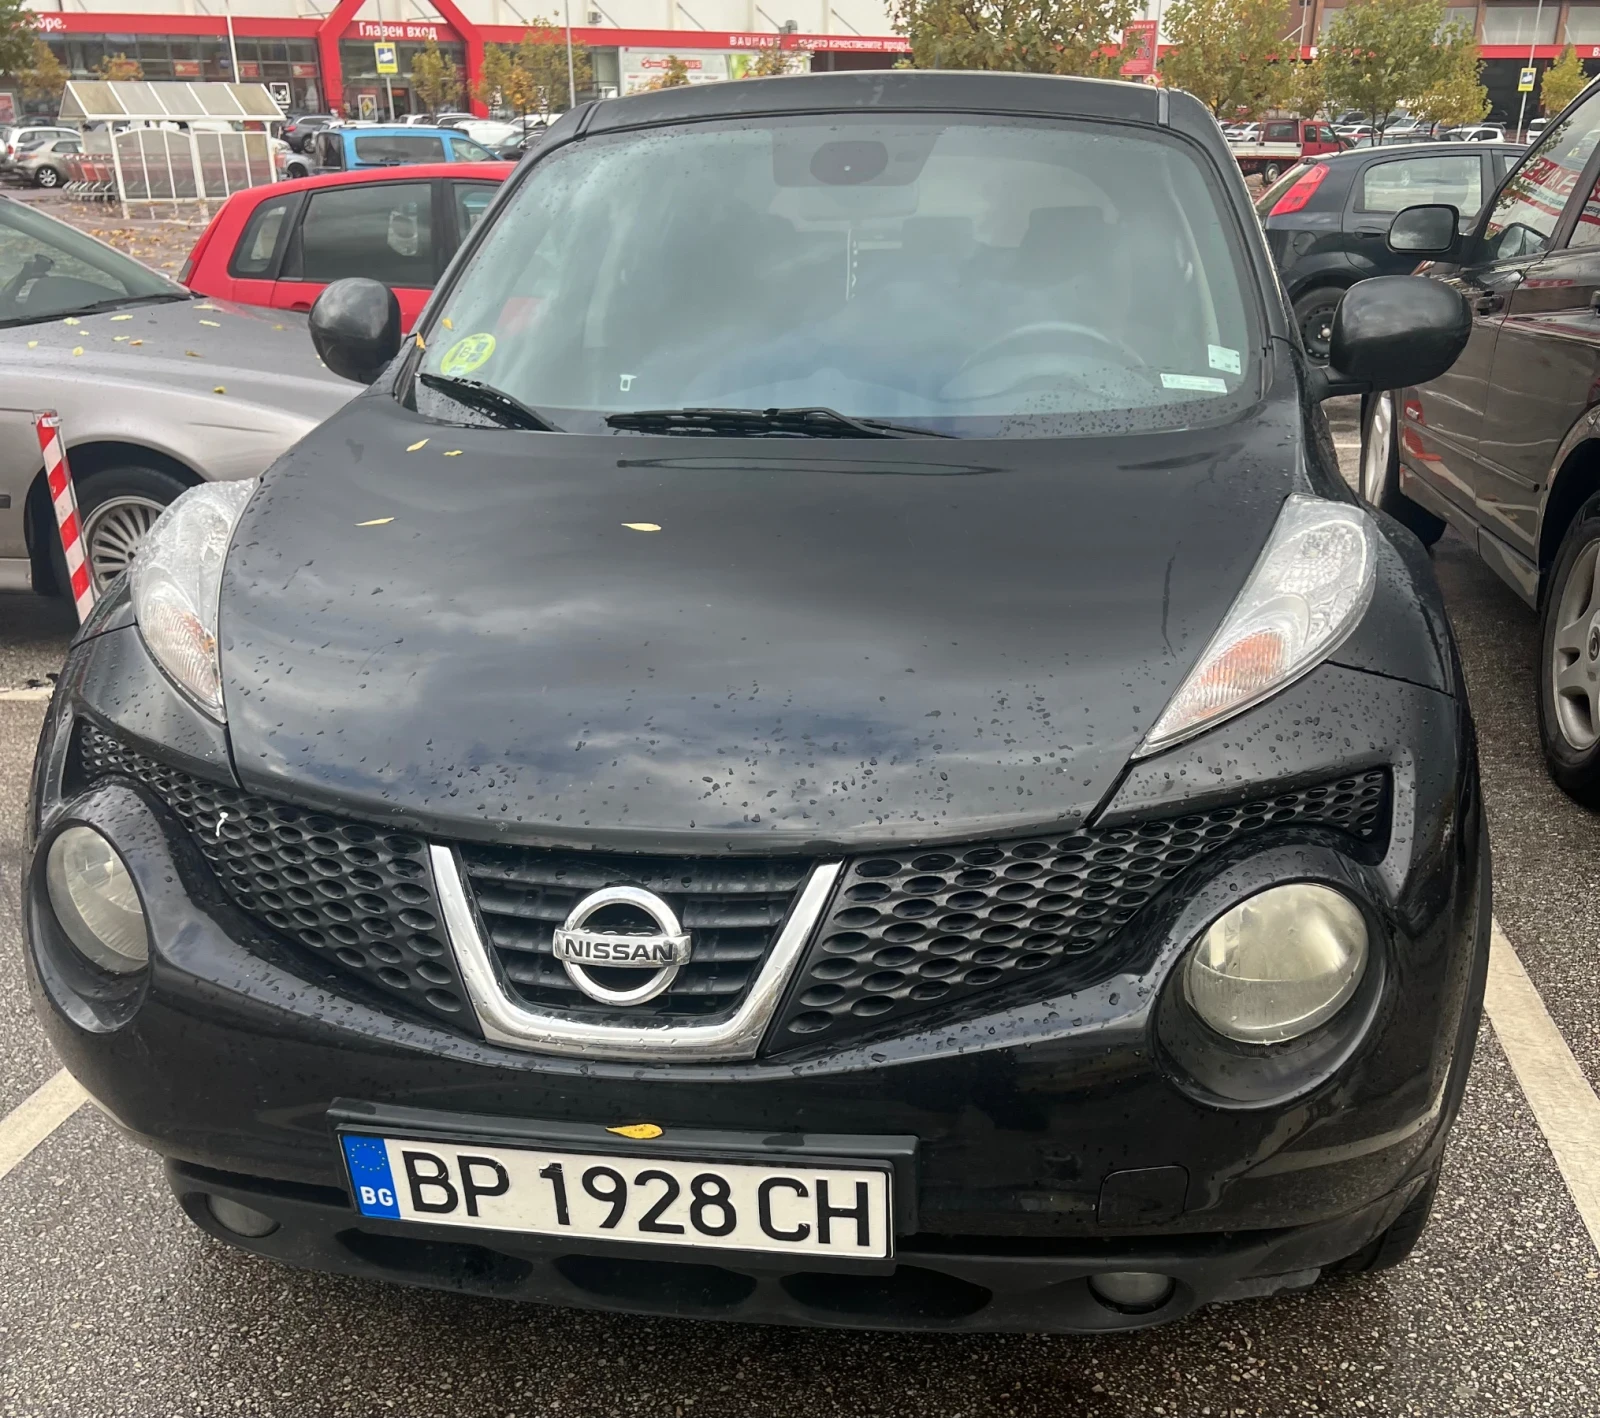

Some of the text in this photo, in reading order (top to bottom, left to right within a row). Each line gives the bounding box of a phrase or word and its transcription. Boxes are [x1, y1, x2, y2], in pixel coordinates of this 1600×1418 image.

[564, 937, 675, 961] NISSAN
[360, 1186, 394, 1207] BG
[402, 1150, 871, 1247] BP 1928 CH
